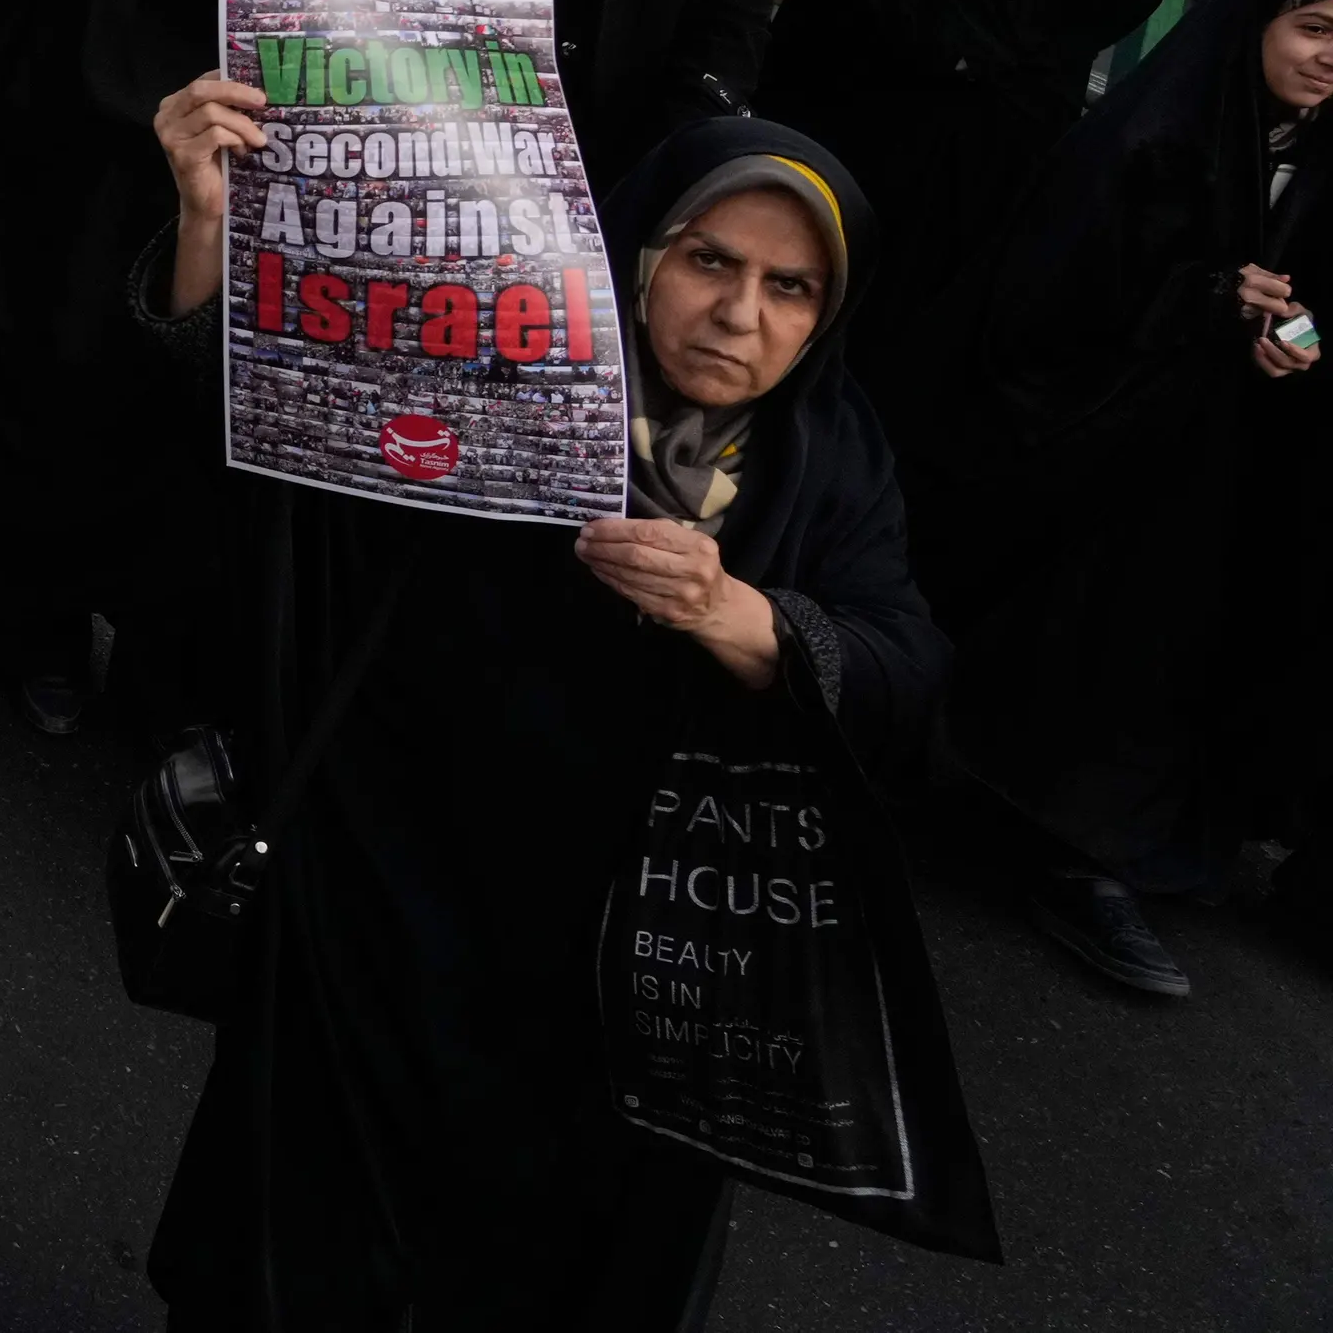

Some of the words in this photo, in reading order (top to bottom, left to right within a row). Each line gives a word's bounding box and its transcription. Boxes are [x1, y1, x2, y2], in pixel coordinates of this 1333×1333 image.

[258, 35, 485, 110] Victory
[487, 41, 546, 107] in
[261, 122, 463, 178] Second
[469, 122, 559, 176] War
[260, 182, 578, 259] Against
[257, 252, 594, 363] Israel
[420, 458, 450, 468] Tasnim
[647, 789, 827, 851] PANTS
[639, 857, 838, 928] HOUSE
[634, 973, 660, 1001] IS
[671, 980, 702, 1009] IN
